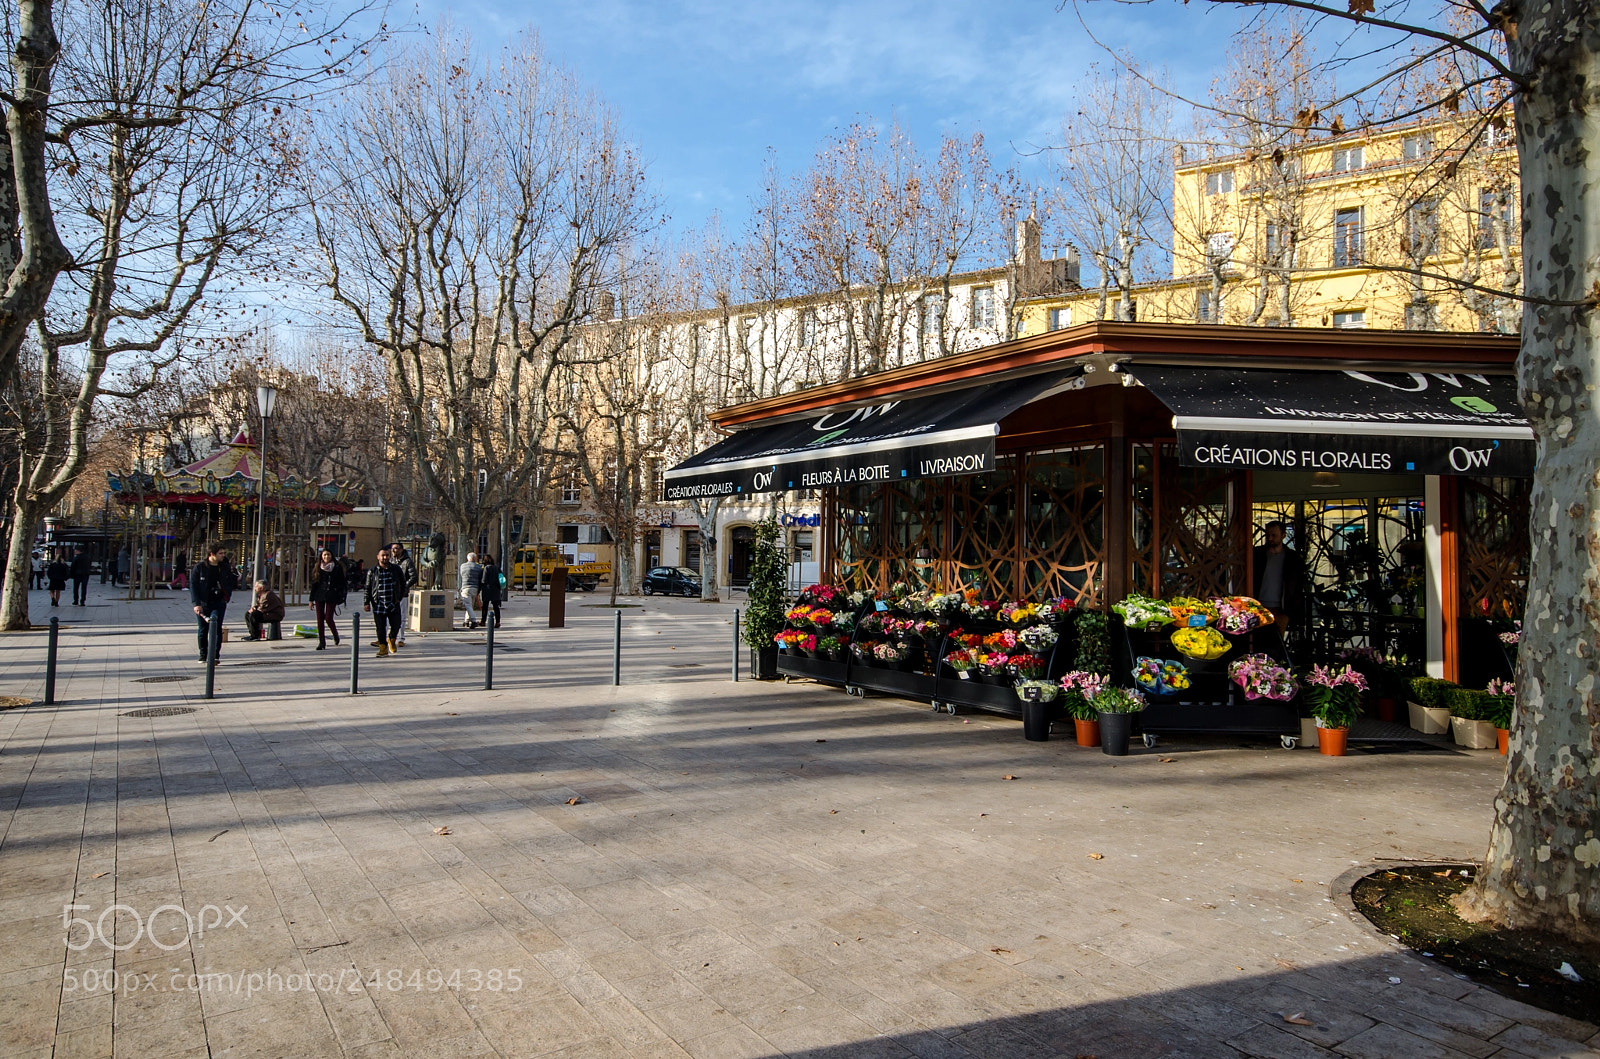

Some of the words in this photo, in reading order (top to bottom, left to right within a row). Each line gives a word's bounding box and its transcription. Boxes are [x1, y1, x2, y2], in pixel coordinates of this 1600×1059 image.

[1194, 444, 1297, 467] CRÉATIONS
[1301, 450, 1392, 470] FLORALES
[667, 485, 701, 499] CRÉATIONS
[700, 481, 733, 496] FLORALES
[802, 470, 833, 487] FLEURS
[844, 468, 857, 483] LA
[859, 464, 890, 481] BOTTE
[919, 453, 986, 476] LIVRAISON
